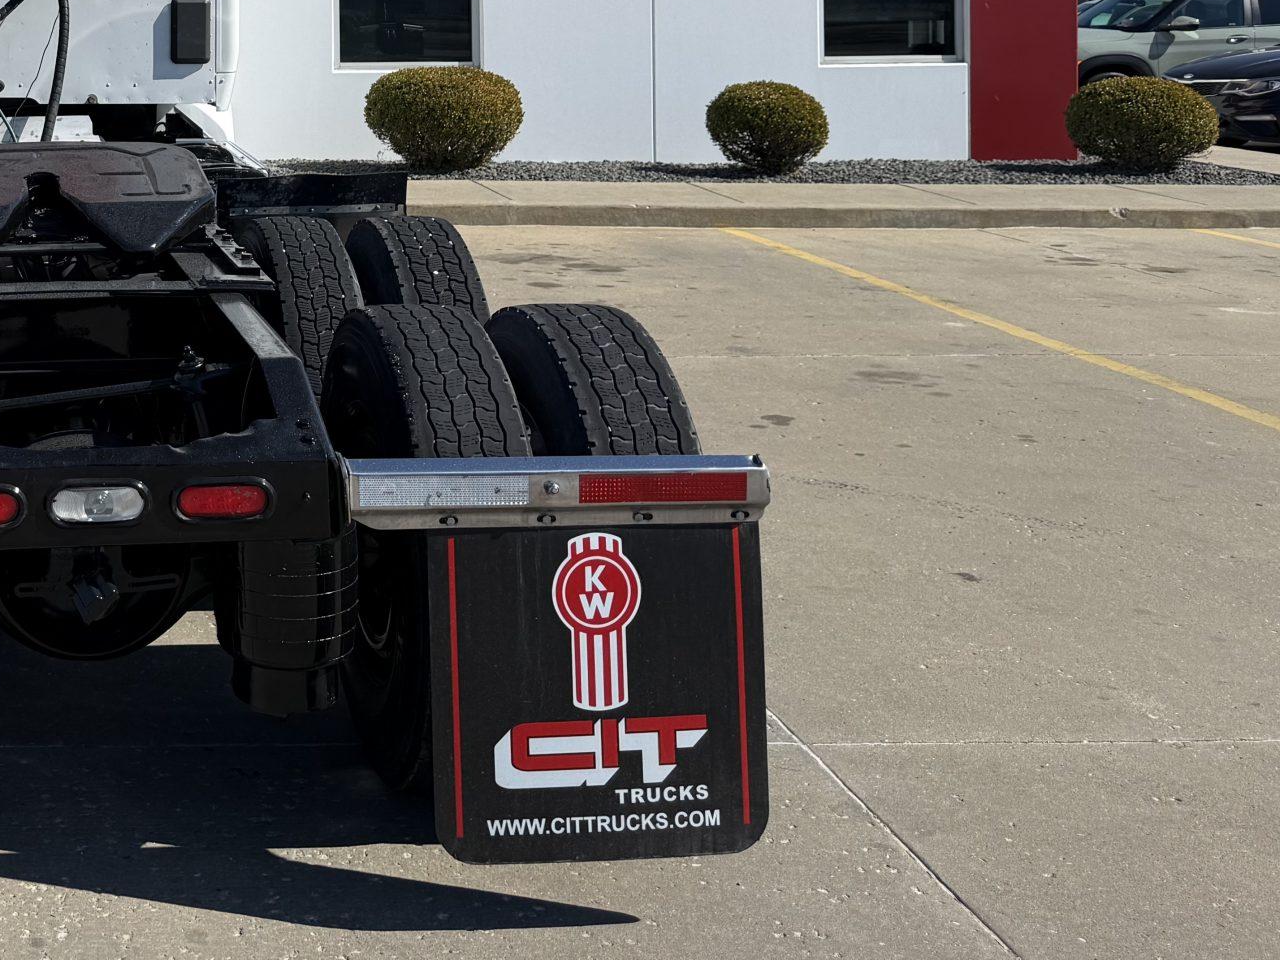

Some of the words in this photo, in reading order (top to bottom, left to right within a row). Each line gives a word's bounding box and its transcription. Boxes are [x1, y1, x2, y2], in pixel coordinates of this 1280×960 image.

[585, 564, 609, 592] K
[578, 591, 615, 620] W
[494, 714, 708, 790] CIT
[615, 784, 709, 805] TRUCKS
[486, 808, 721, 837] WWW.CITTRUCKS.COM
